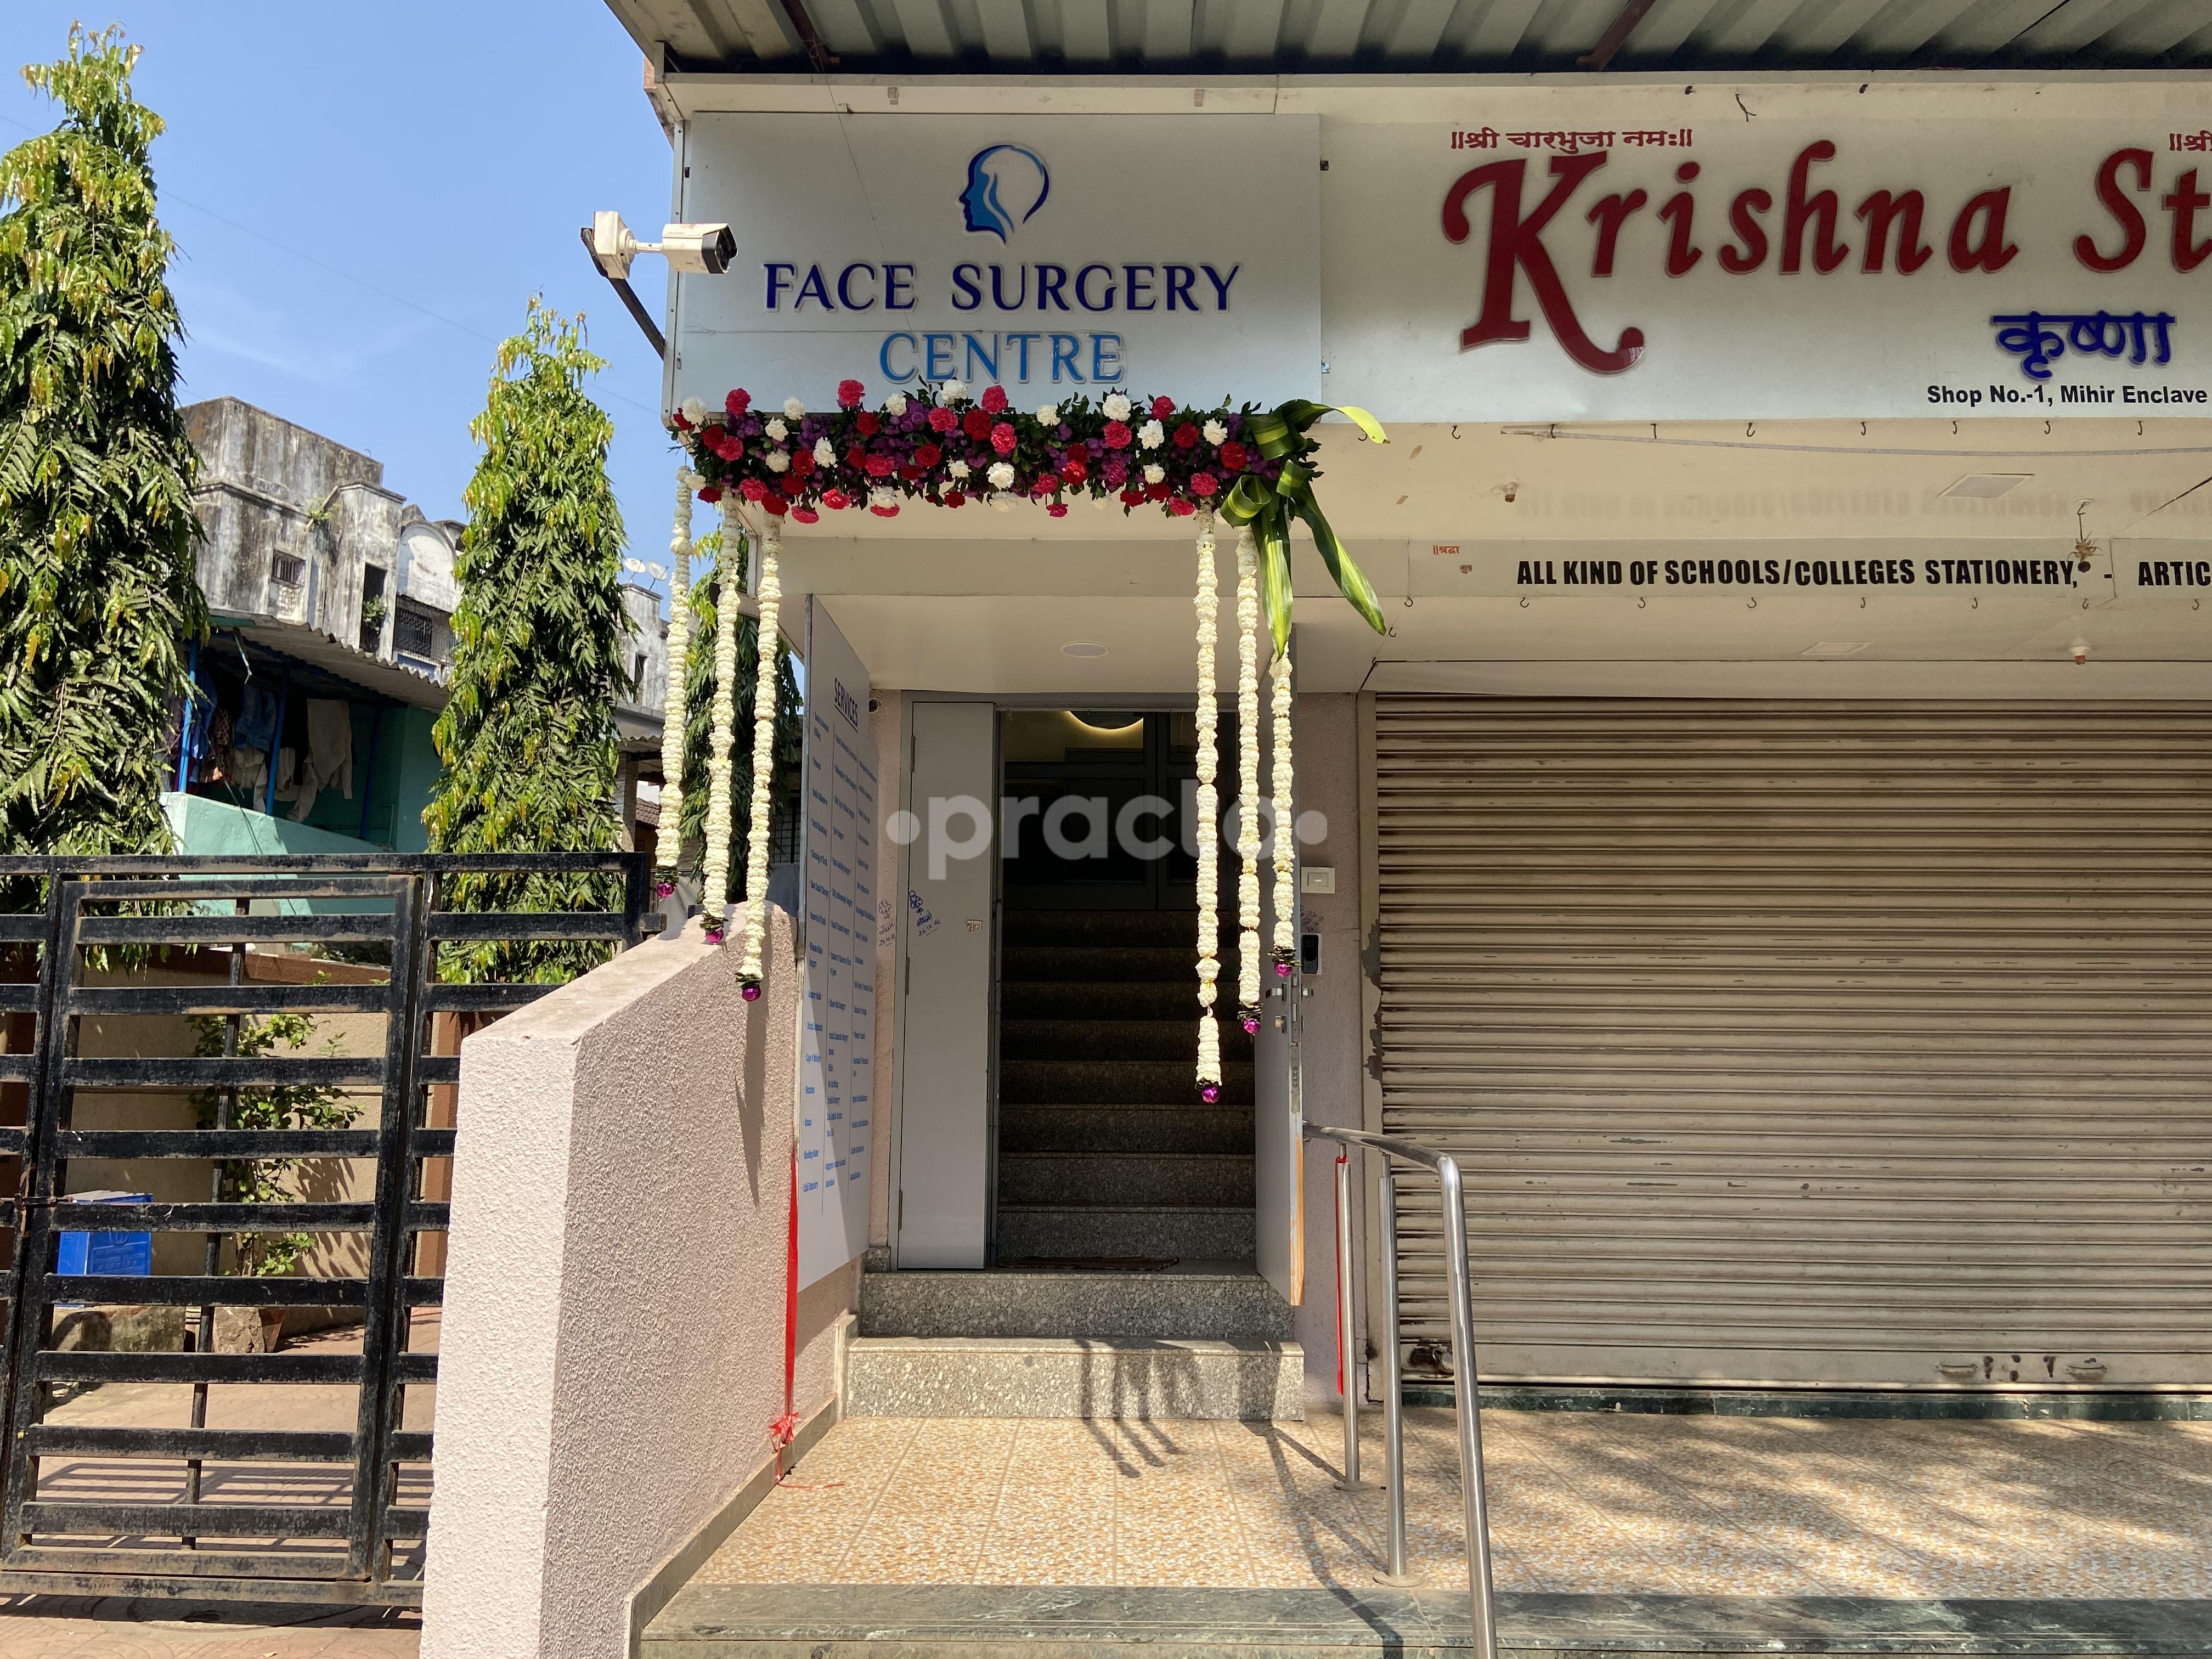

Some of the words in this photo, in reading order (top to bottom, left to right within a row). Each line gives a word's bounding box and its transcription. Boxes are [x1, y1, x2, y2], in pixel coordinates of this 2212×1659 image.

[1505, 131, 1616, 154] चारभुजा
[1442, 140, 2019, 373] Krishna
[765, 263, 917, 311] FACE
[952, 263, 1240, 312] SURGERY
[879, 332, 1123, 382] CENTRE
[1991, 311, 2177, 380] कृष्णा
[1927, 386, 1982, 407] Shop
[1990, 386, 2053, 407] No.-1,
[2061, 386, 2115, 403] Mihir
[2123, 386, 2208, 404] Enclave
[1517, 561, 1557, 584] ALL
[1564, 561, 1622, 584] KIND
[1630, 561, 1658, 585] OF
[1665, 560, 1916, 586] SCHOOLS/COLLEGES
[1926, 560, 2078, 589] STATIONERY,
[834, 677, 859, 728] SERVICES
